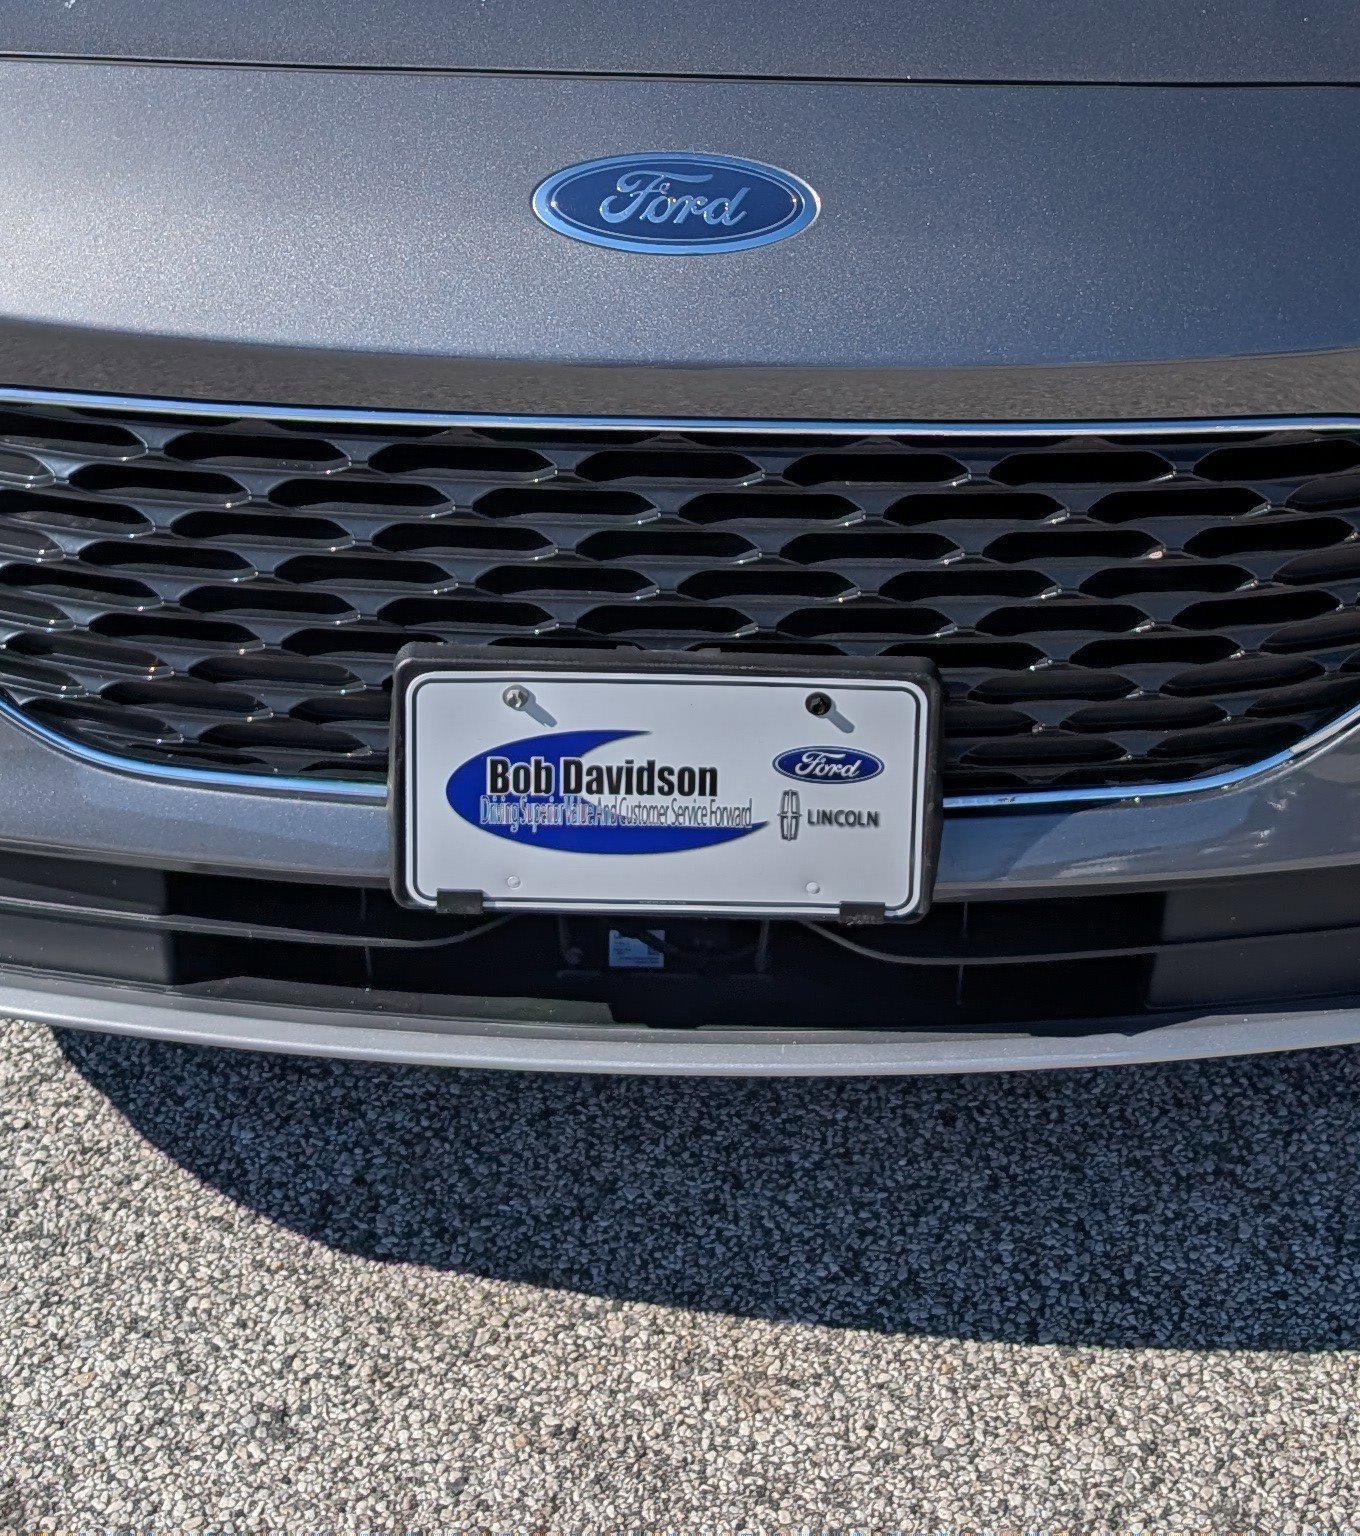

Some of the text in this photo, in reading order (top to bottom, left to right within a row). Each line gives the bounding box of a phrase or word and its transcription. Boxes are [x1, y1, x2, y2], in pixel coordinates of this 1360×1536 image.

[600, 170, 751, 226] Ford
[487, 757, 718, 797] Bob Davidson
[795, 751, 862, 777] Ford
[480, 795, 753, 833] Driving Superior Value And Customer Service Forward
[807, 809, 880, 827] LINCOLN
